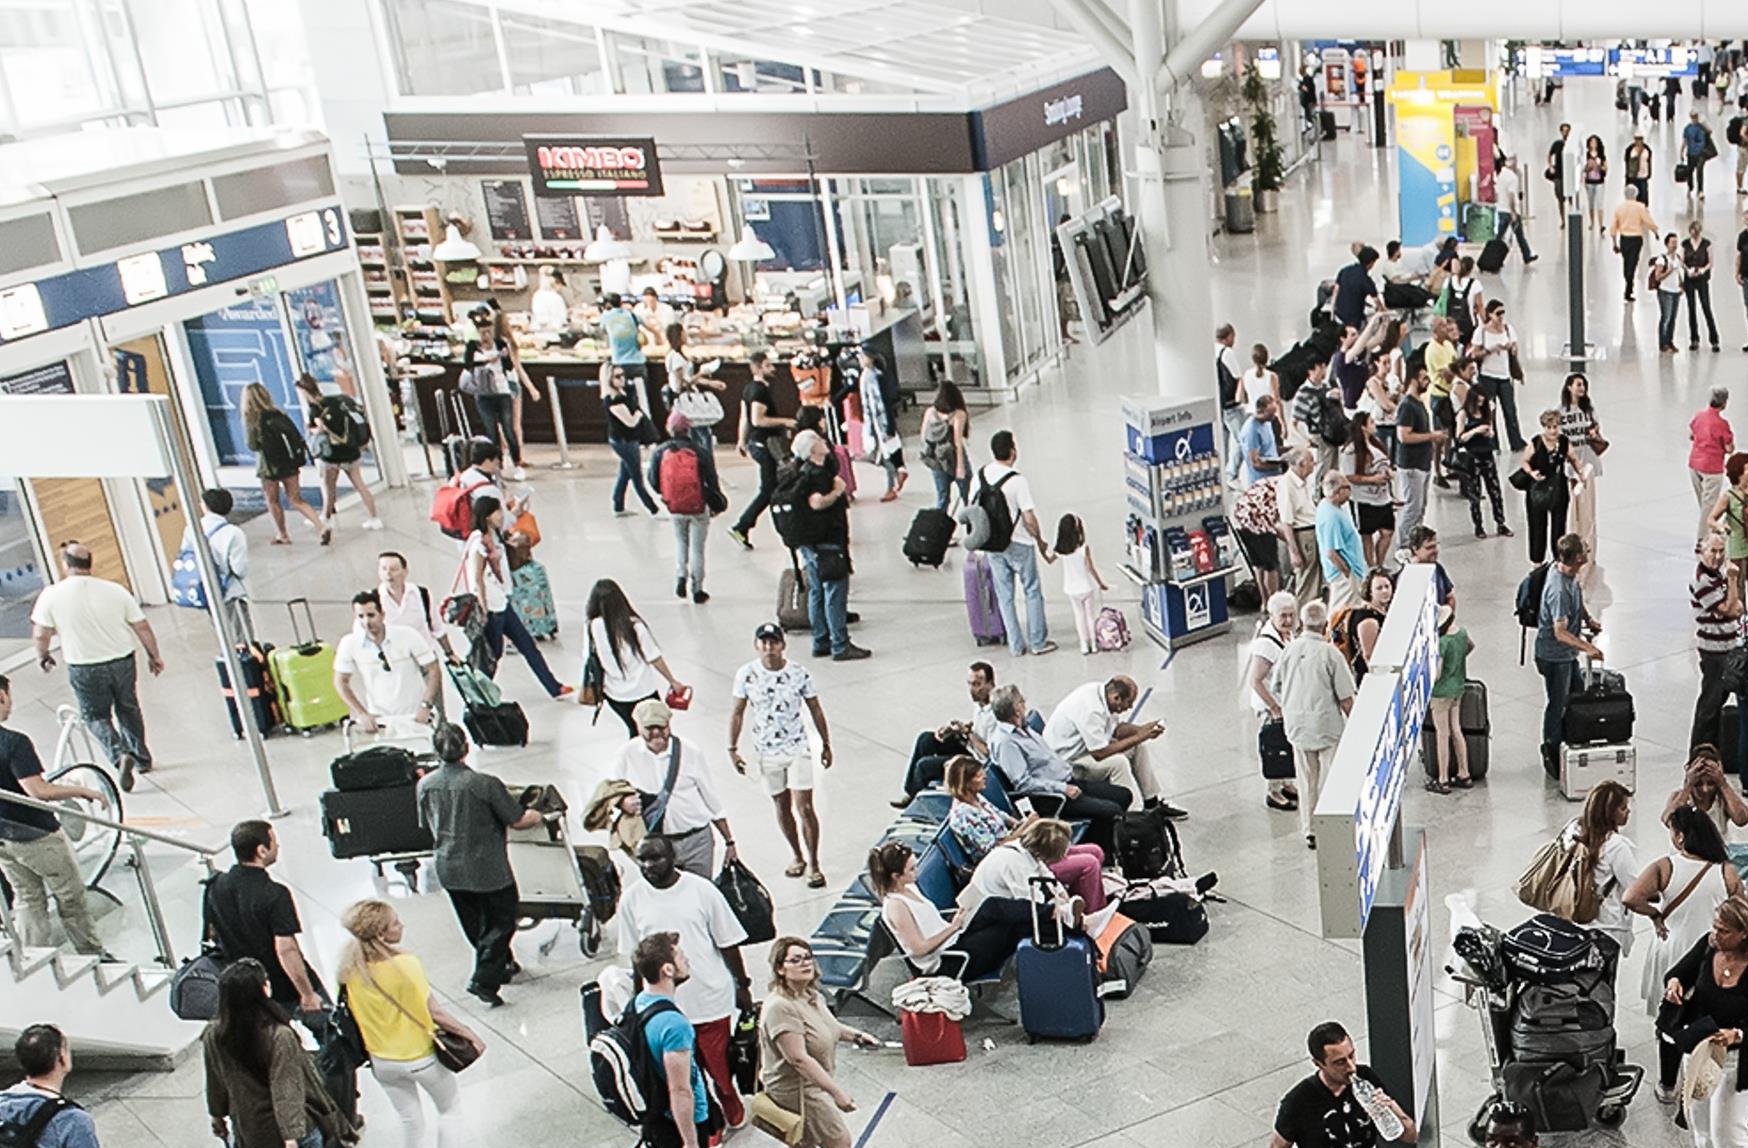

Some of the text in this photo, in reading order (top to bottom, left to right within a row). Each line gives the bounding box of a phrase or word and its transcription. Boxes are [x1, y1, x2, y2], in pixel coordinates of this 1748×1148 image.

[537, 145, 646, 170] KIMBO
[542, 168, 648, 179] ESPRESSO ITALIANO
[1151, 410, 1193, 428] Airport Info
